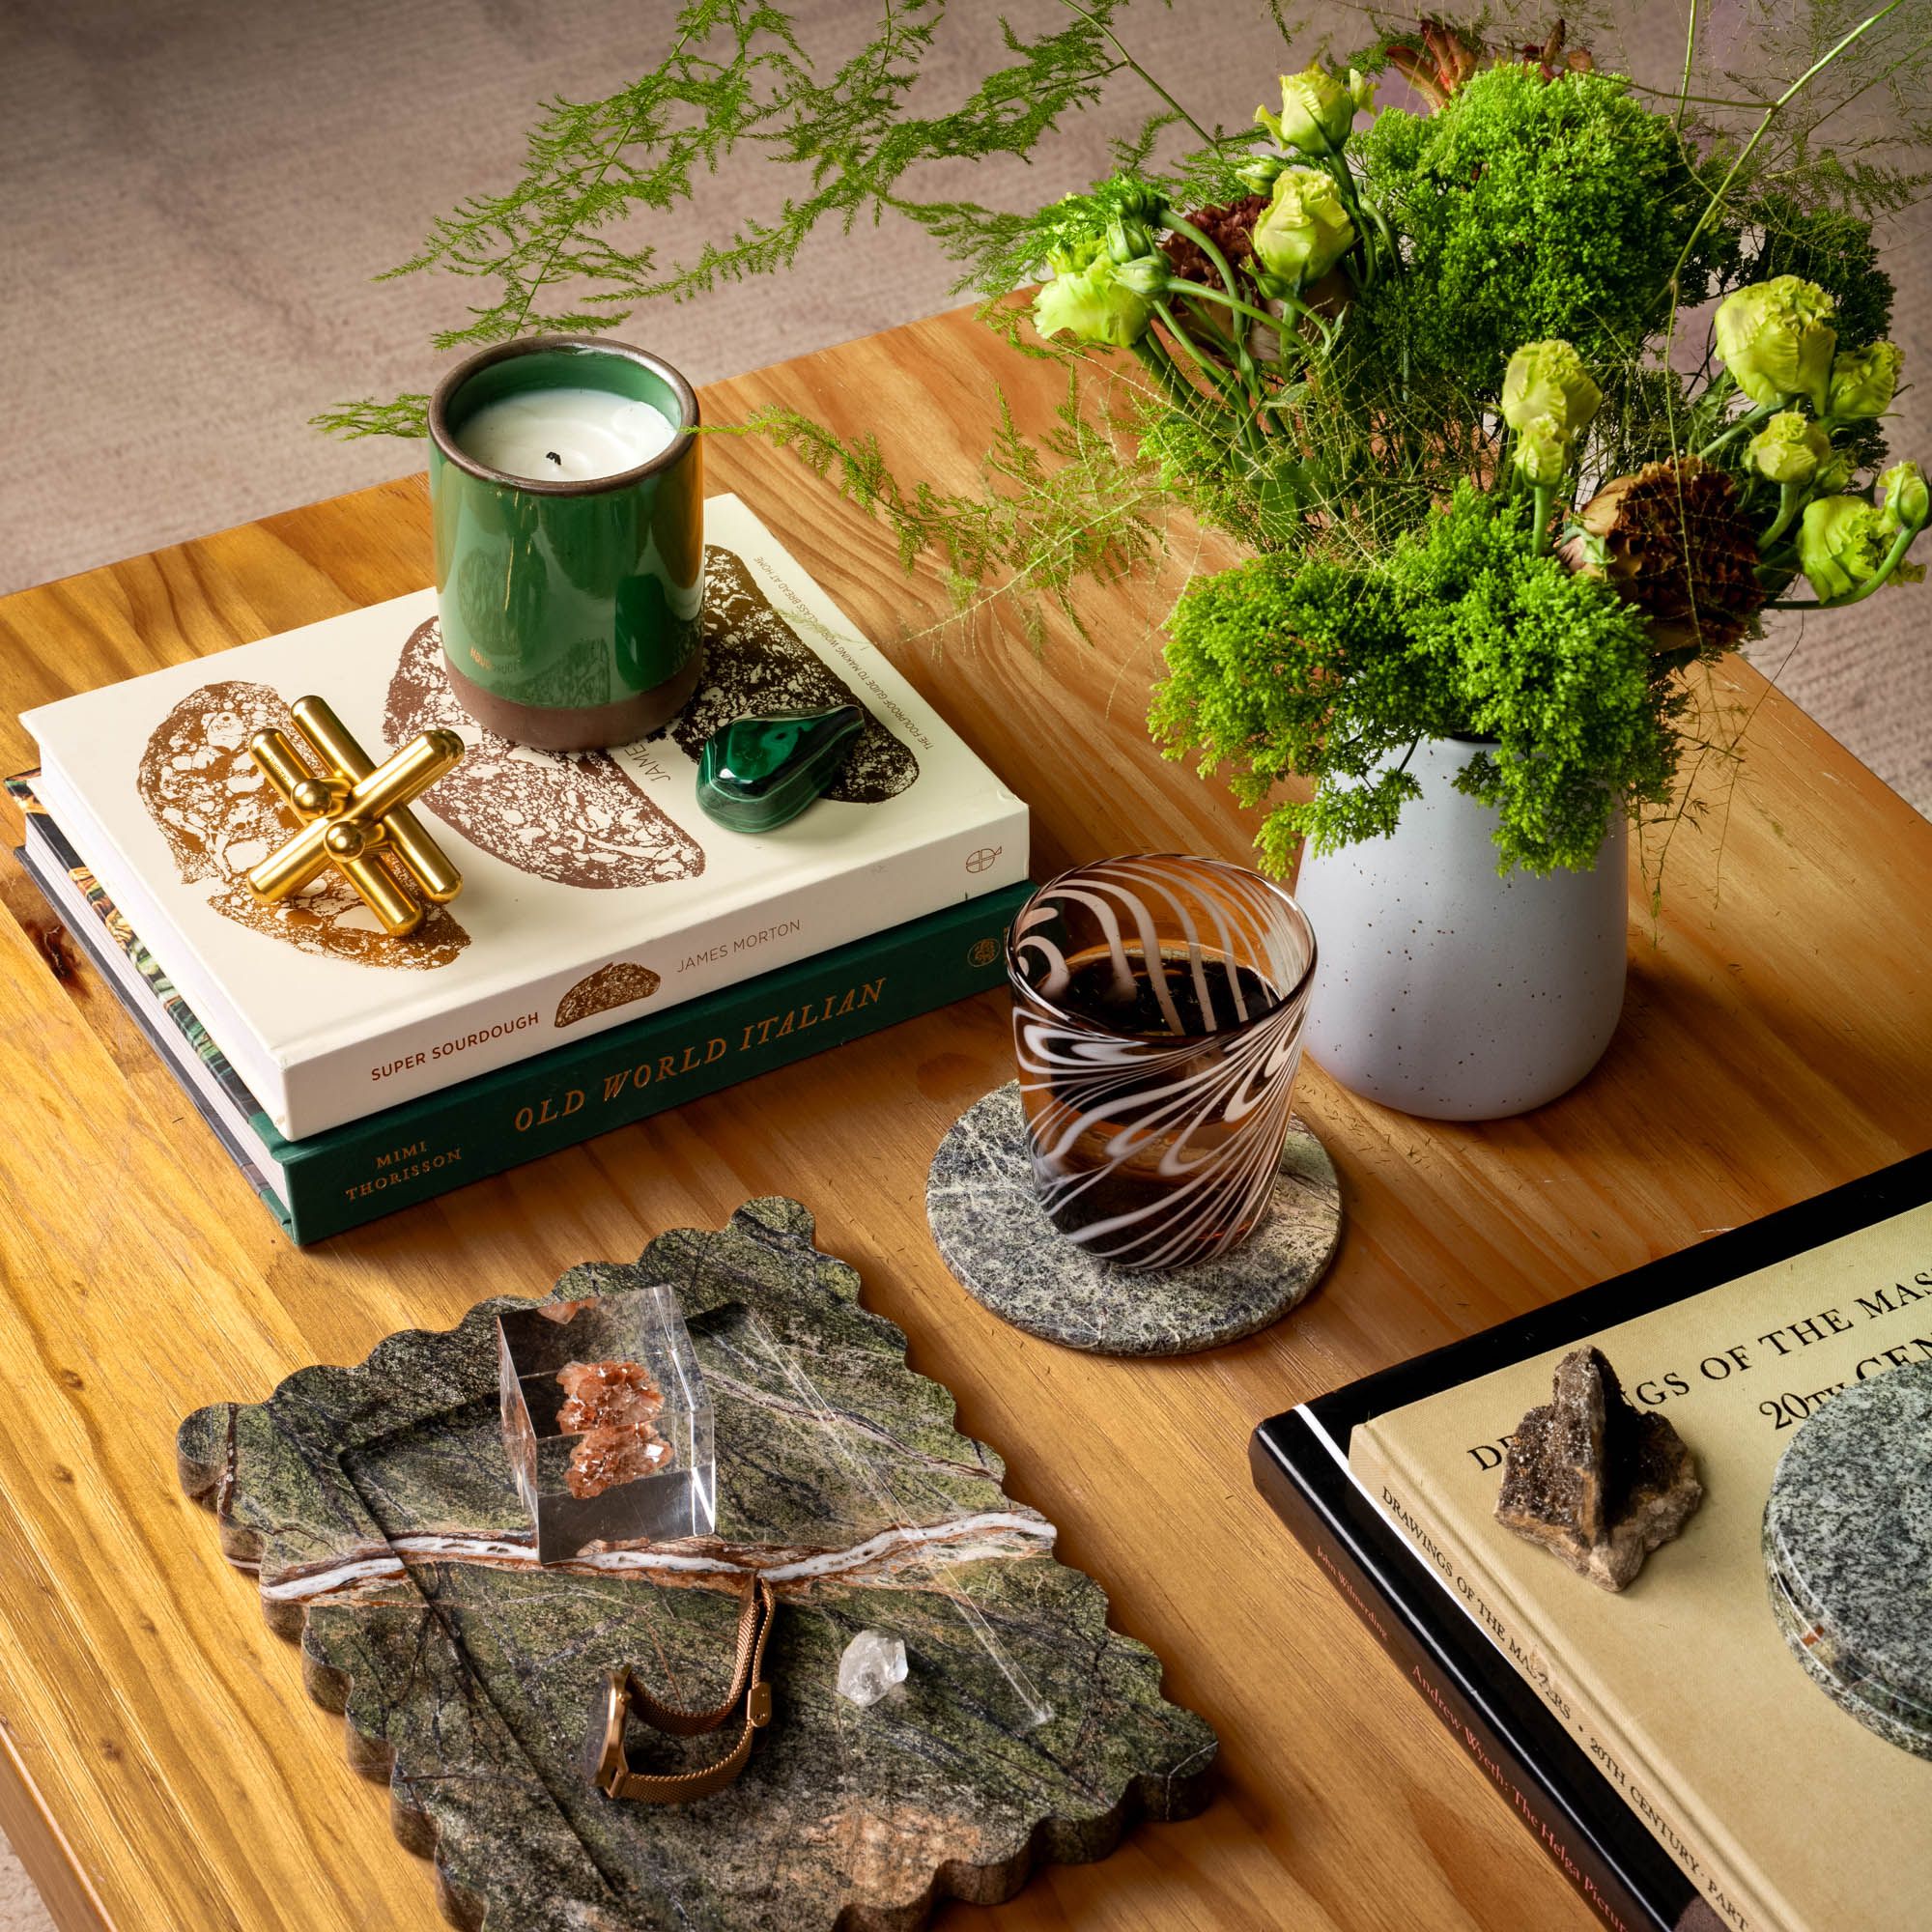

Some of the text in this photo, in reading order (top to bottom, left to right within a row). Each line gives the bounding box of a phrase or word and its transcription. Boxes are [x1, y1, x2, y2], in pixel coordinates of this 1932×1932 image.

[754, 556, 775, 575] HOME
[779, 582, 802, 605] BREAD
[836, 646, 861, 671] MAKING
[857, 669, 869, 681] TO
[866, 679, 889, 700] GUIDE
[883, 699, 921, 737] FOOLPROOF
[918, 735, 935, 750] THE
[676, 919, 800, 973] JAMES MORTON
[371, 1011, 539, 1081] SUPER SOURDOUGH
[514, 977, 887, 1132] OLD WORLD ITALIAN
[376, 1141, 427, 1169] MIMI
[345, 1148, 463, 1202] THORISSON
[1700, 1345, 1752, 1380] OF
[1757, 1308, 1855, 1356] THE
[1759, 1382, 1846, 1431] 20T
[1317, 1545, 1338, 1577] John
[1382, 1486, 1453, 1577] DRAWINGS
[1457, 1577, 1475, 1602] OF
[1477, 1599, 1506, 1642] THE
[1590, 1737, 1626, 1787] 20TH
[1630, 1785, 1700, 1874] CENTURY
[1707, 1879, 1748, 1932] PART
[1412, 1664, 1462, 1729] Andrew
[1464, 1726, 1509, 1790] Wyeth:
[1512, 1785, 1538, 1828] The
[1541, 1823, 1581, 1881] Helga
